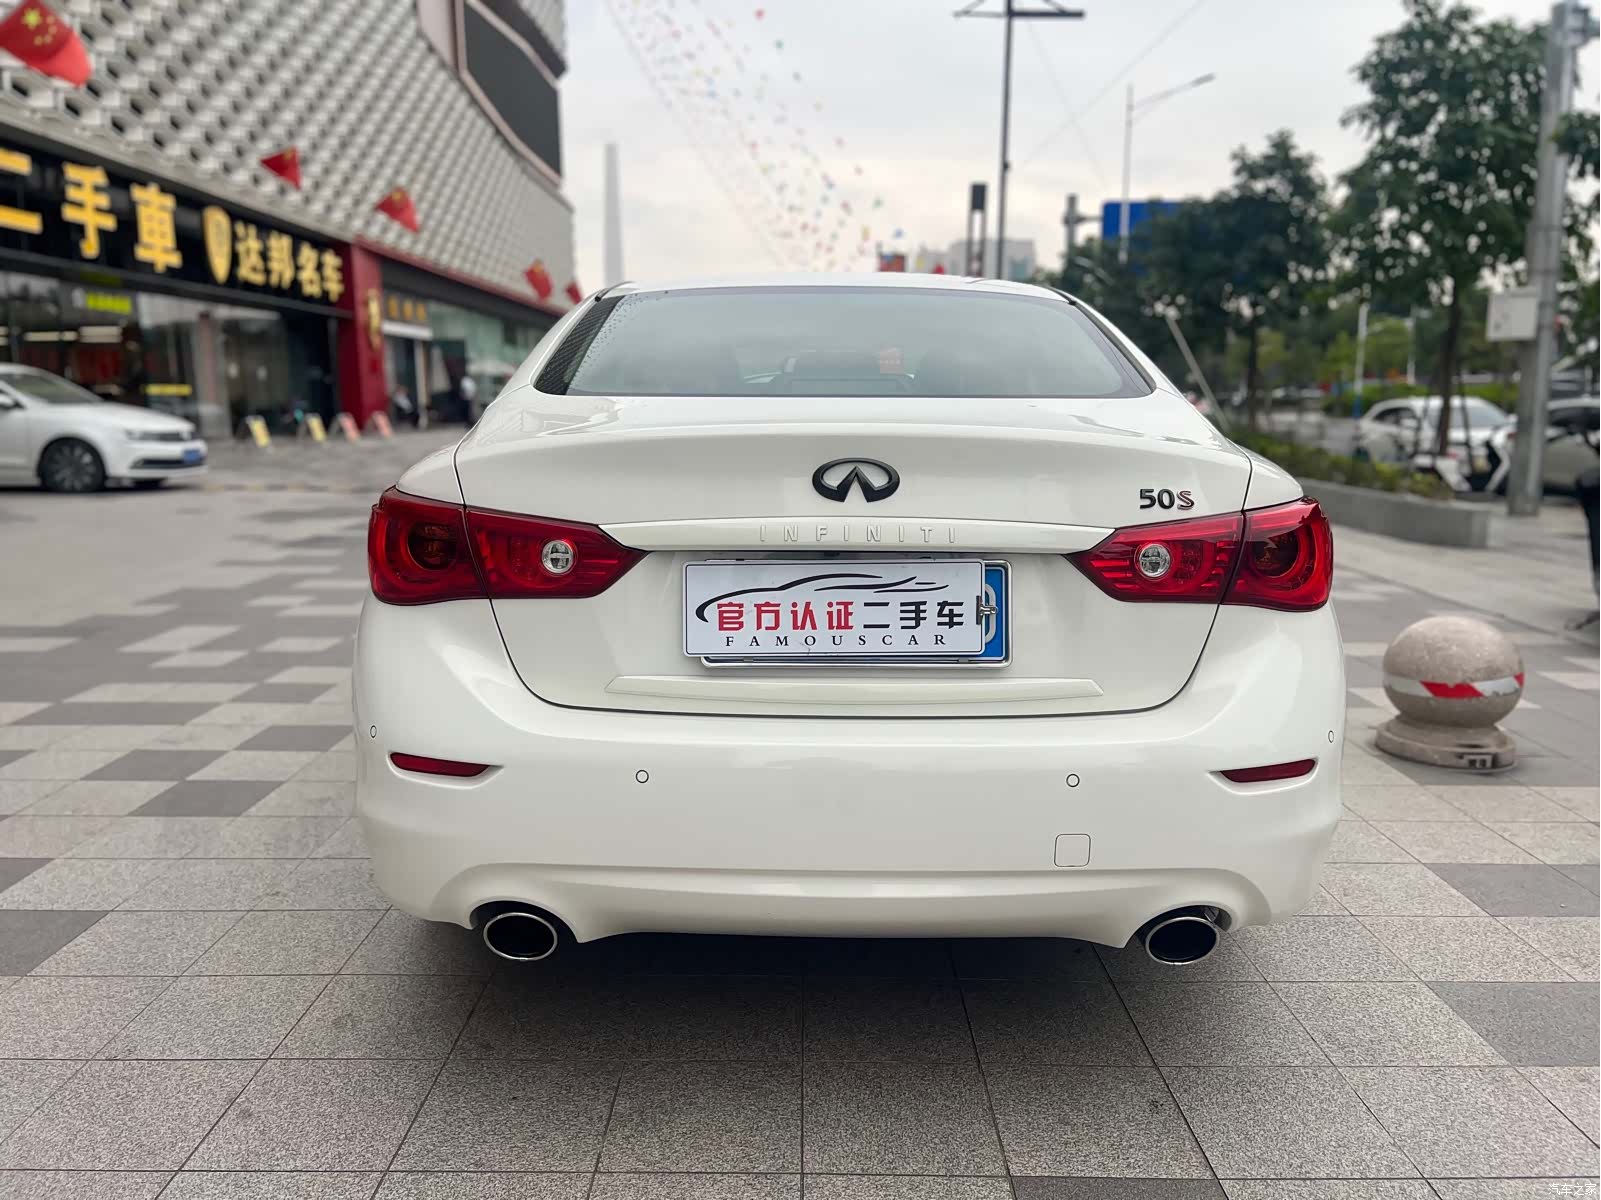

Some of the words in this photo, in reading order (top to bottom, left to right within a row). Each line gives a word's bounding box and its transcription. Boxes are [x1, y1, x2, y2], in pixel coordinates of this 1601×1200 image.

[0, 148, 183, 273] 二手車
[234, 210, 345, 303] 达邦名车
[1139, 488, 1195, 511] 50S
[759, 524, 957, 544] INFINITI
[716, 600, 964, 631] 官方认证二手车
